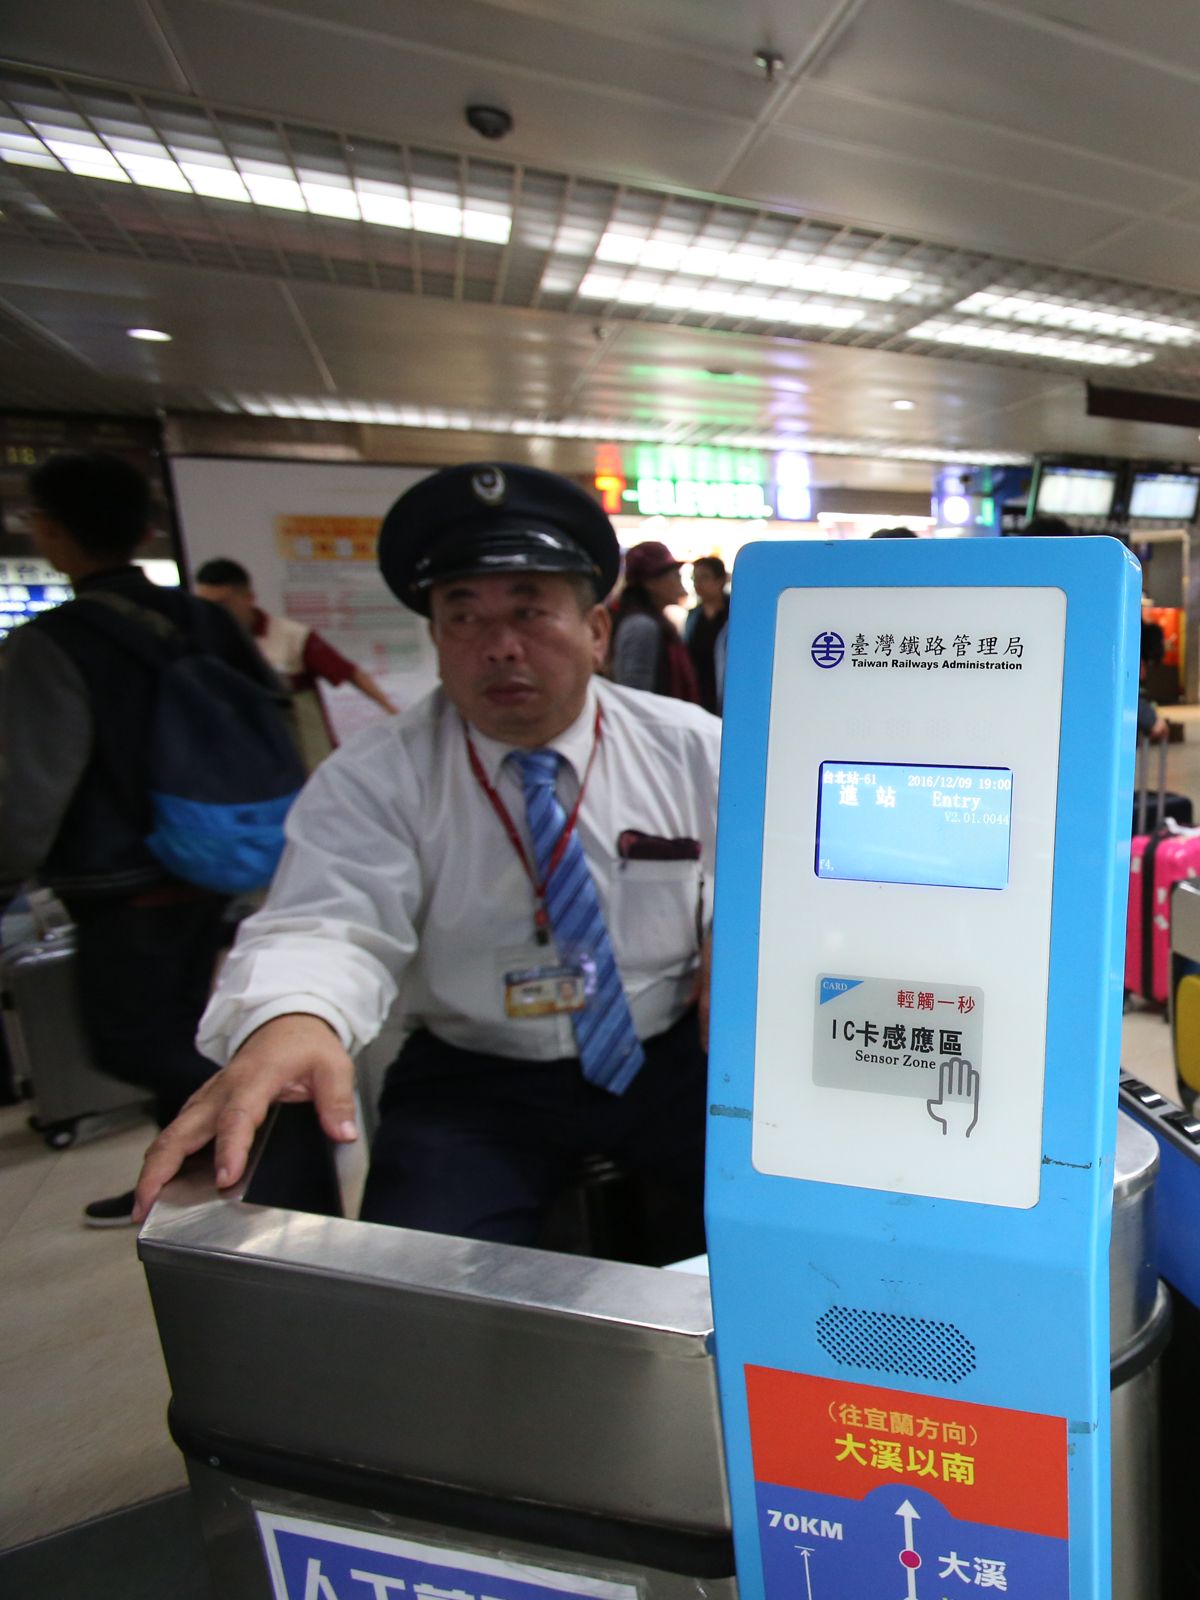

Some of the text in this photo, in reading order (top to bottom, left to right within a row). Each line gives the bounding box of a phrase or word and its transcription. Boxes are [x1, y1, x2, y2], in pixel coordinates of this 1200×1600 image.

[850, 632, 1025, 659] 臺灣鐵路管理局
[851, 658, 1023, 671] Taiwan Railways Administration
[907, 774, 973, 789] 2016/12/09
[978, 777, 1012, 791] 19:00
[931, 790, 981, 811] Entry
[822, 981, 848, 991] CARD
[896, 989, 976, 1014] 輕觸一秒
[832, 1019, 963, 1057] IC卡感應區
[855, 1050, 936, 1070] Sensor Zone
[834, 1432, 976, 1486] 大溪以南
[767, 1509, 844, 1541] 70KM
[938, 1551, 1008, 1592] 大溪
